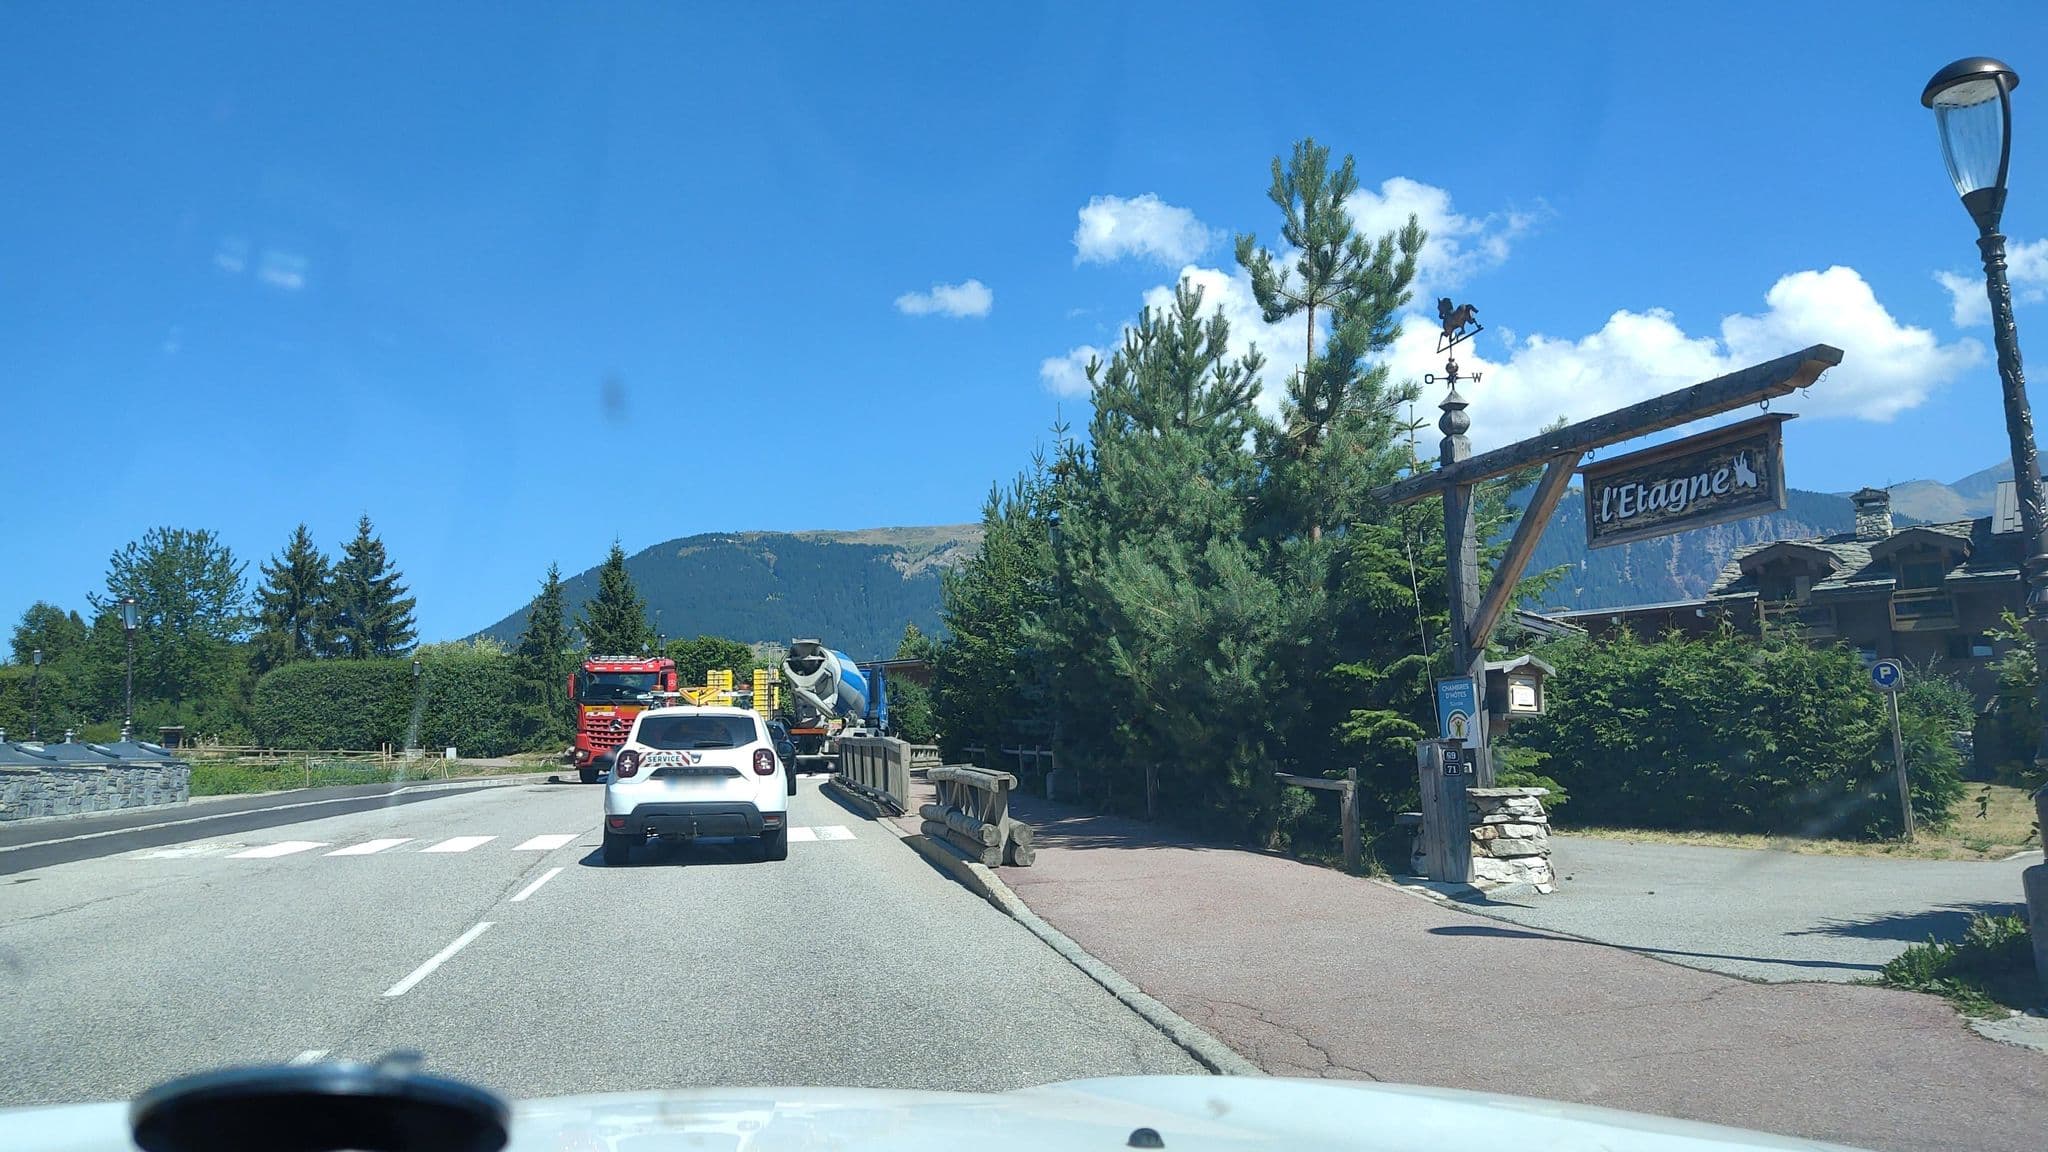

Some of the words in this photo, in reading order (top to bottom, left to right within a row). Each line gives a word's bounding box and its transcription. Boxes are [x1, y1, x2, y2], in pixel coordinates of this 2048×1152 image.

[1600, 467, 1730, 523] l'Etagne
[1880, 666, 1891, 679] P
[1441, 684, 1469, 692] CHAMBRES
[647, 755, 681, 763] SERVICE
[1447, 765, 1457, 774] 71
